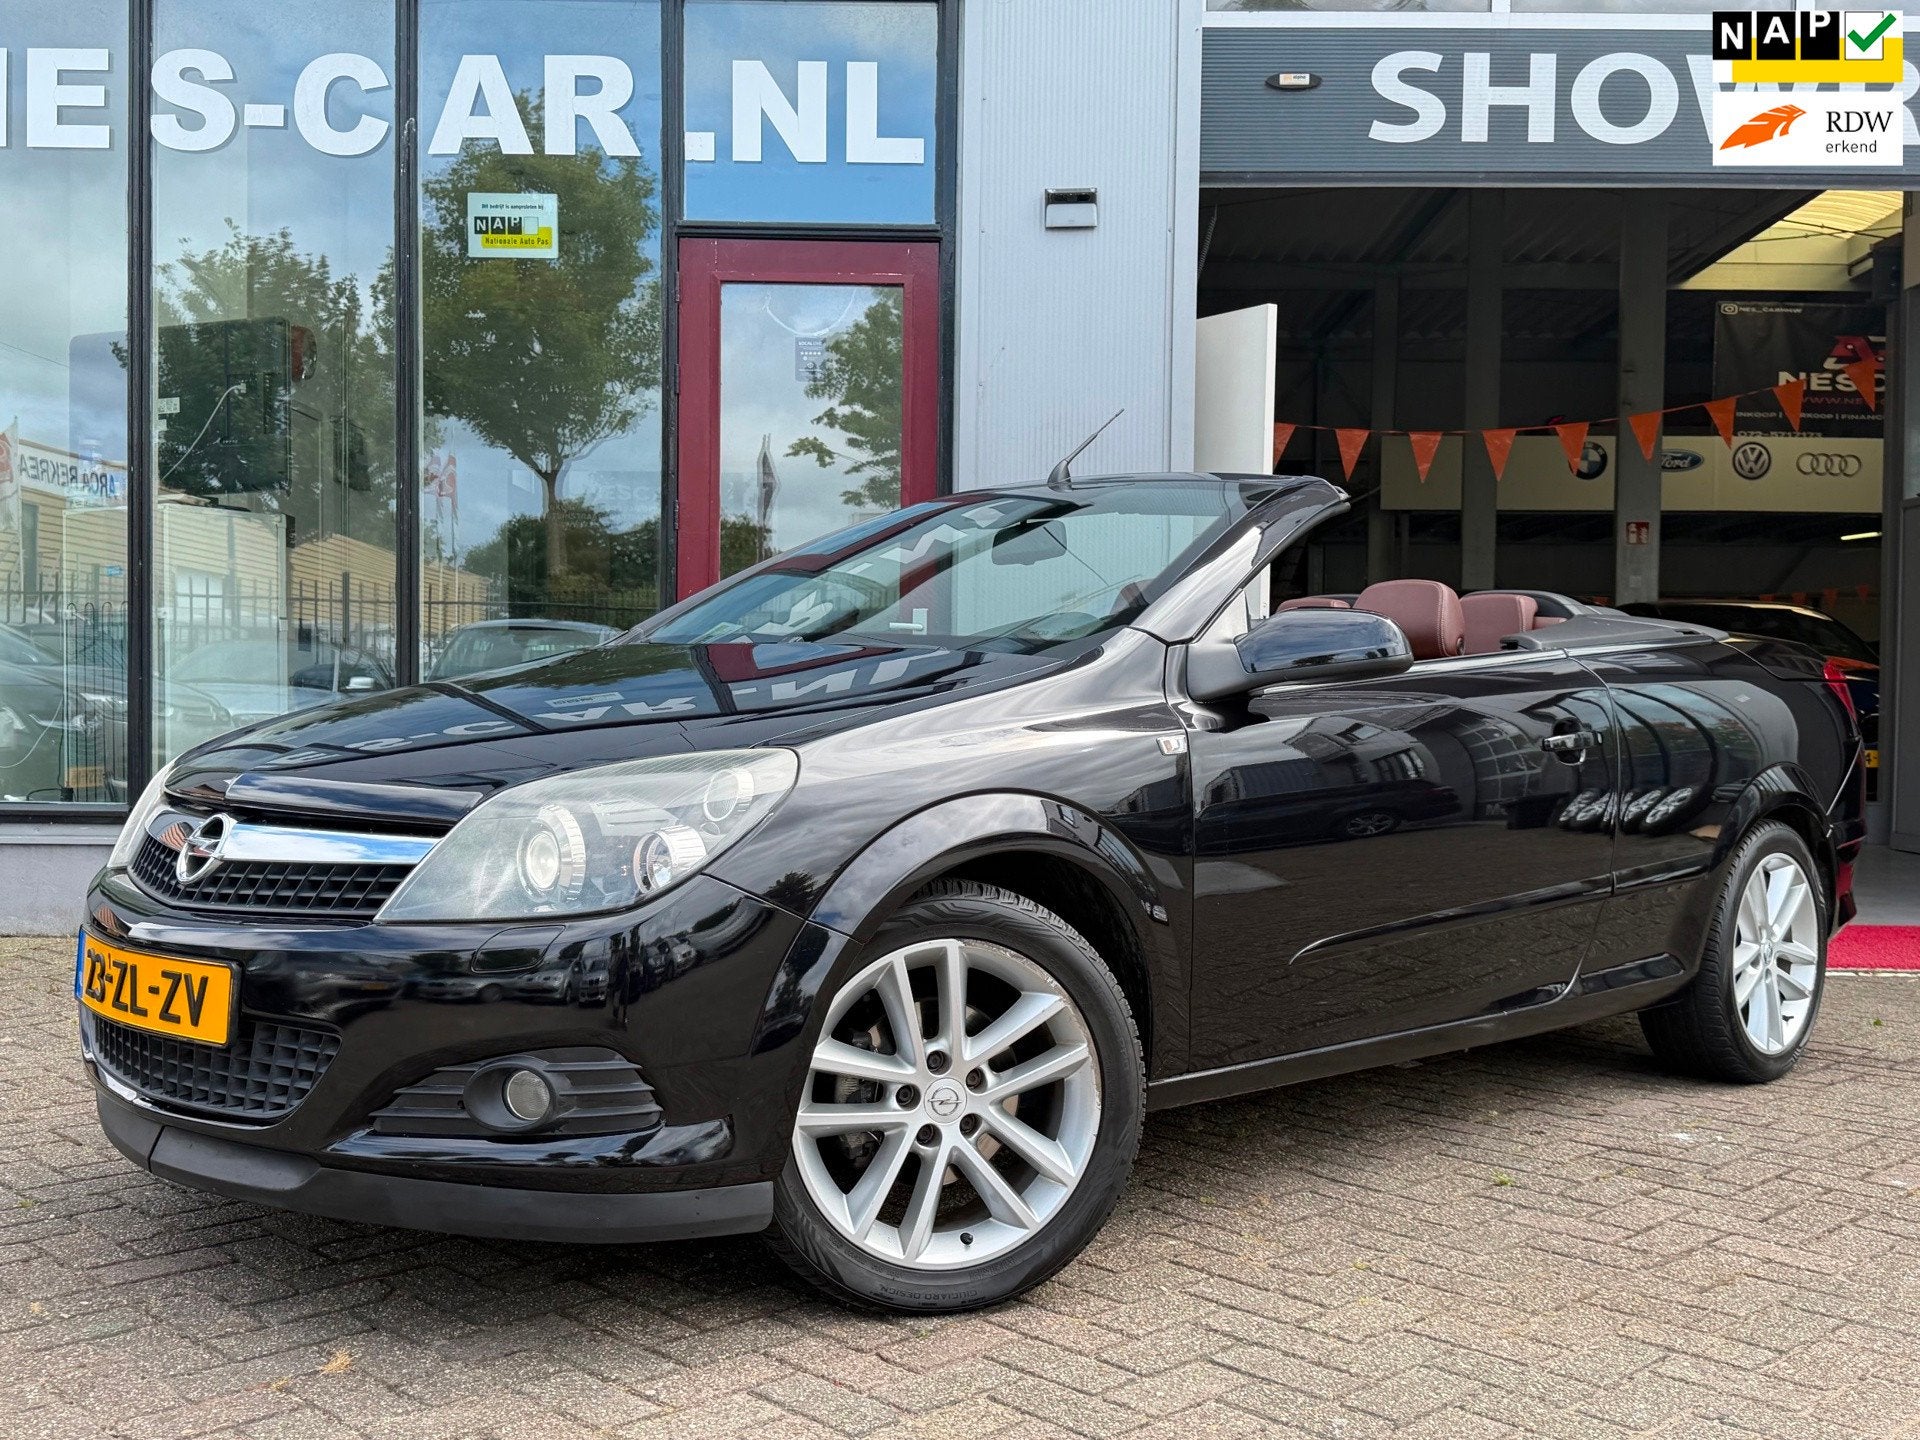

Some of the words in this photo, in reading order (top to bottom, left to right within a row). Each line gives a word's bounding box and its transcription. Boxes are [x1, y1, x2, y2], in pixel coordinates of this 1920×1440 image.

[476, 217, 520, 231] NAP
[485, 237, 517, 245] Nationale
[519, 237, 535, 245] Auto
[537, 237, 549, 245] Pas
[85, 947, 209, 1028] 23-ZL-ZV
